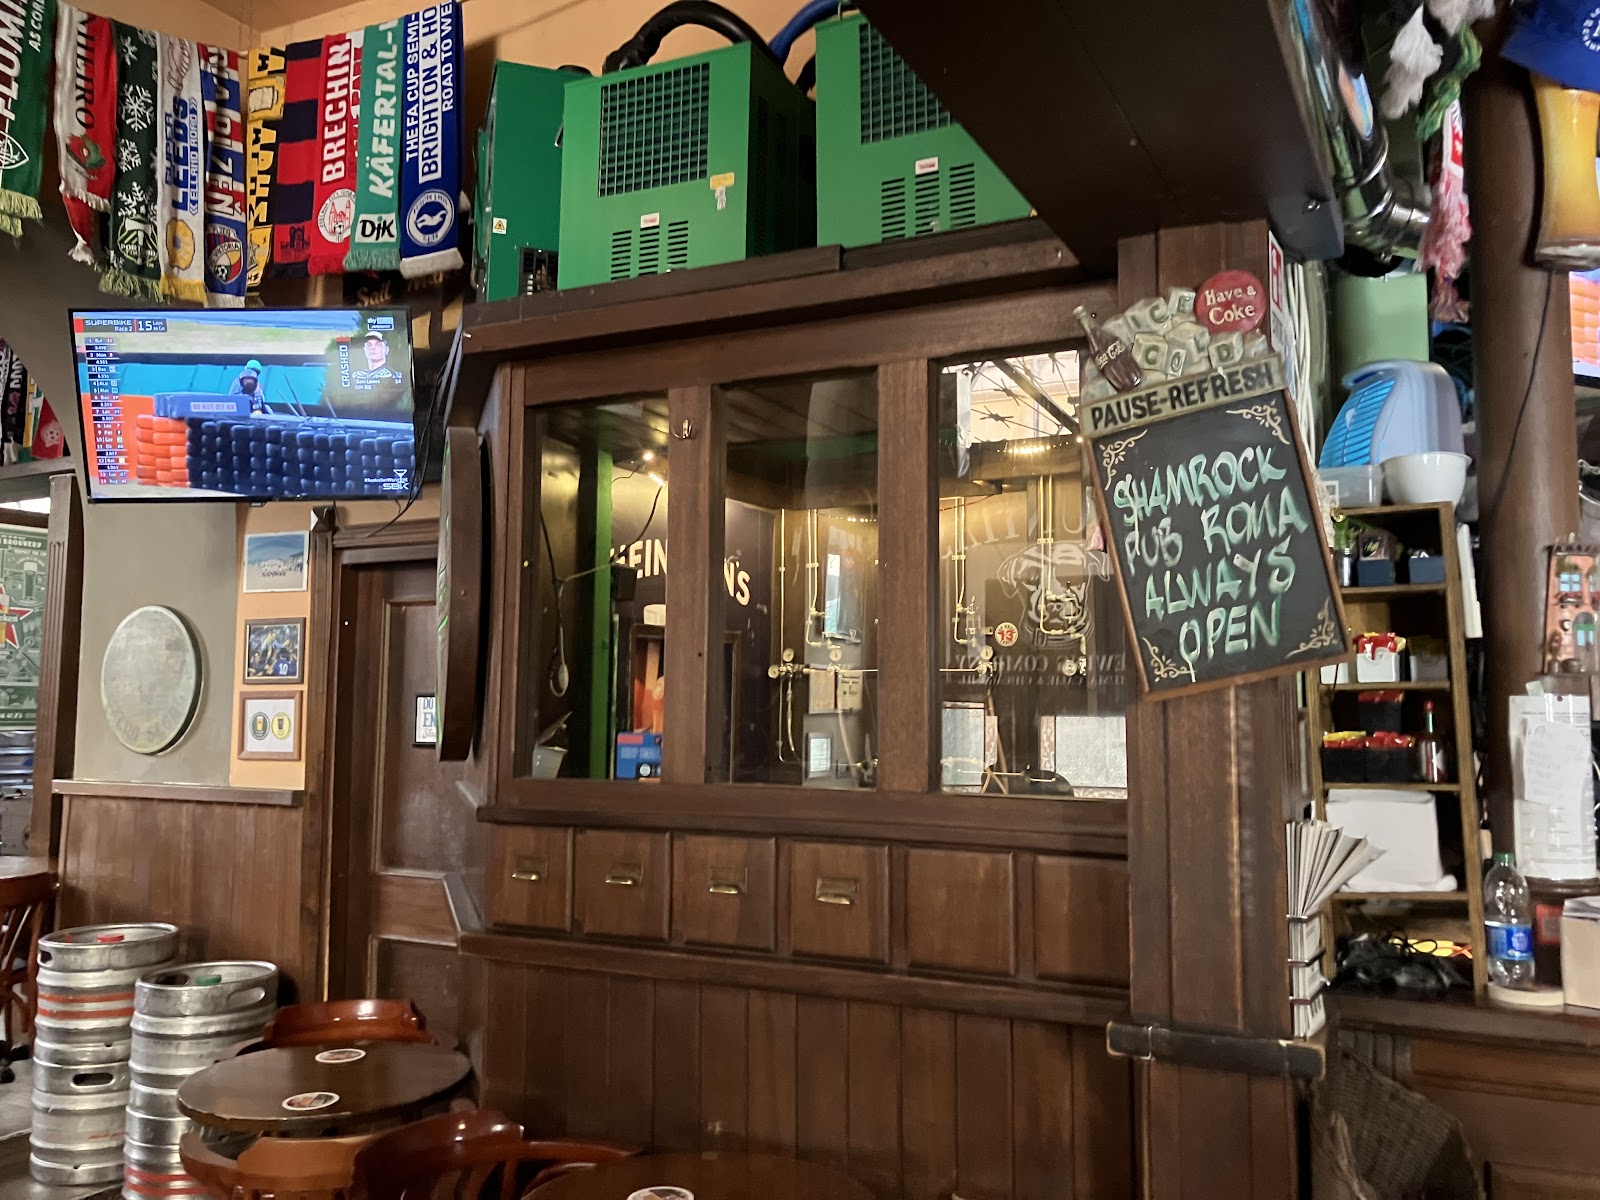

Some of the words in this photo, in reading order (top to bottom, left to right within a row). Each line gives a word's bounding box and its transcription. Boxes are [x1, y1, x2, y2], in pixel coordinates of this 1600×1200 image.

[28, 31, 41, 53] AS
[422, 39, 437, 60] &
[441, 38, 453, 61] TO
[406, 68, 419, 101] CUP
[442, 63, 454, 112] ROAD
[322, 41, 350, 182] BRECHIN
[406, 103, 418, 126] FA
[421, 65, 439, 177] BRIGHTON
[172, 95, 189, 211] LEEDS
[405, 128, 418, 162] THE
[1205, 288, 1243, 306] Have
[1247, 285, 1257, 296] a
[138, 320, 153, 331] 15
[1208, 302, 1255, 325] Coke
[339, 344, 351, 388] CRASHED
[1090, 360, 1275, 431] PAUSE-REFRESH
[382, 482, 410, 490] SBK
[1113, 444, 1287, 528] SHAMROCK
[1125, 516, 1184, 577] PUB
[1200, 486, 1309, 556] ROMA
[1145, 535, 1297, 622] ALWAYS
[1178, 594, 1282, 683] OPEN
[278, 662, 289, 676] 10
